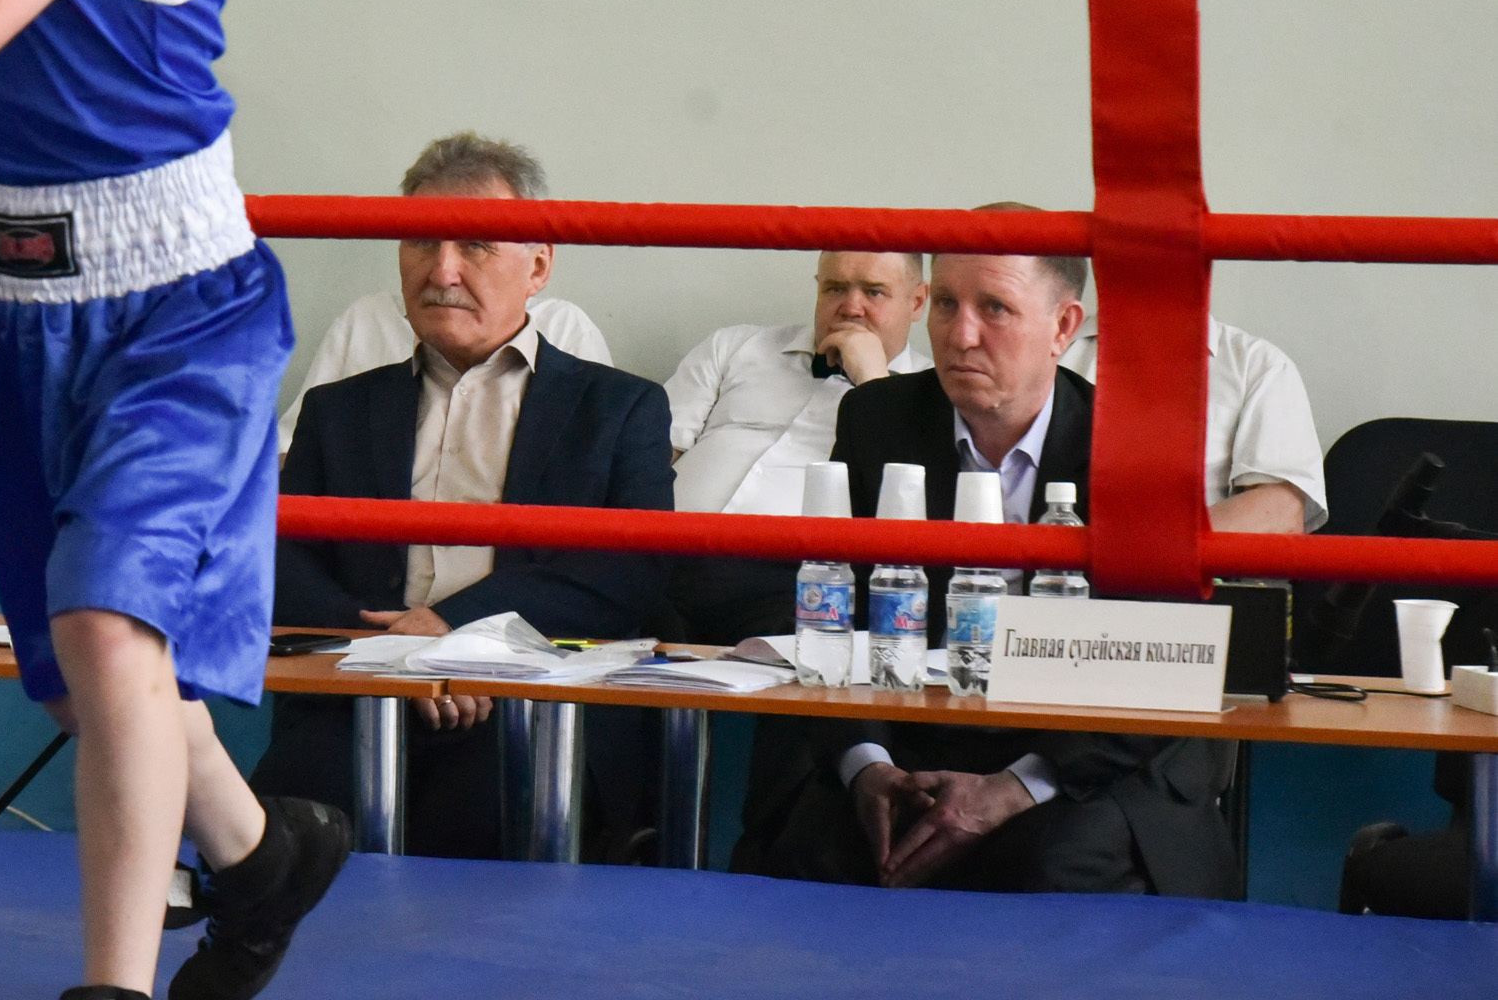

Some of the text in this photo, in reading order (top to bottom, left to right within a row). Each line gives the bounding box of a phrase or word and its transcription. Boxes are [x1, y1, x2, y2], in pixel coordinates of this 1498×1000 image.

[1003, 628, 1217, 668] Главная судейская коллегия
